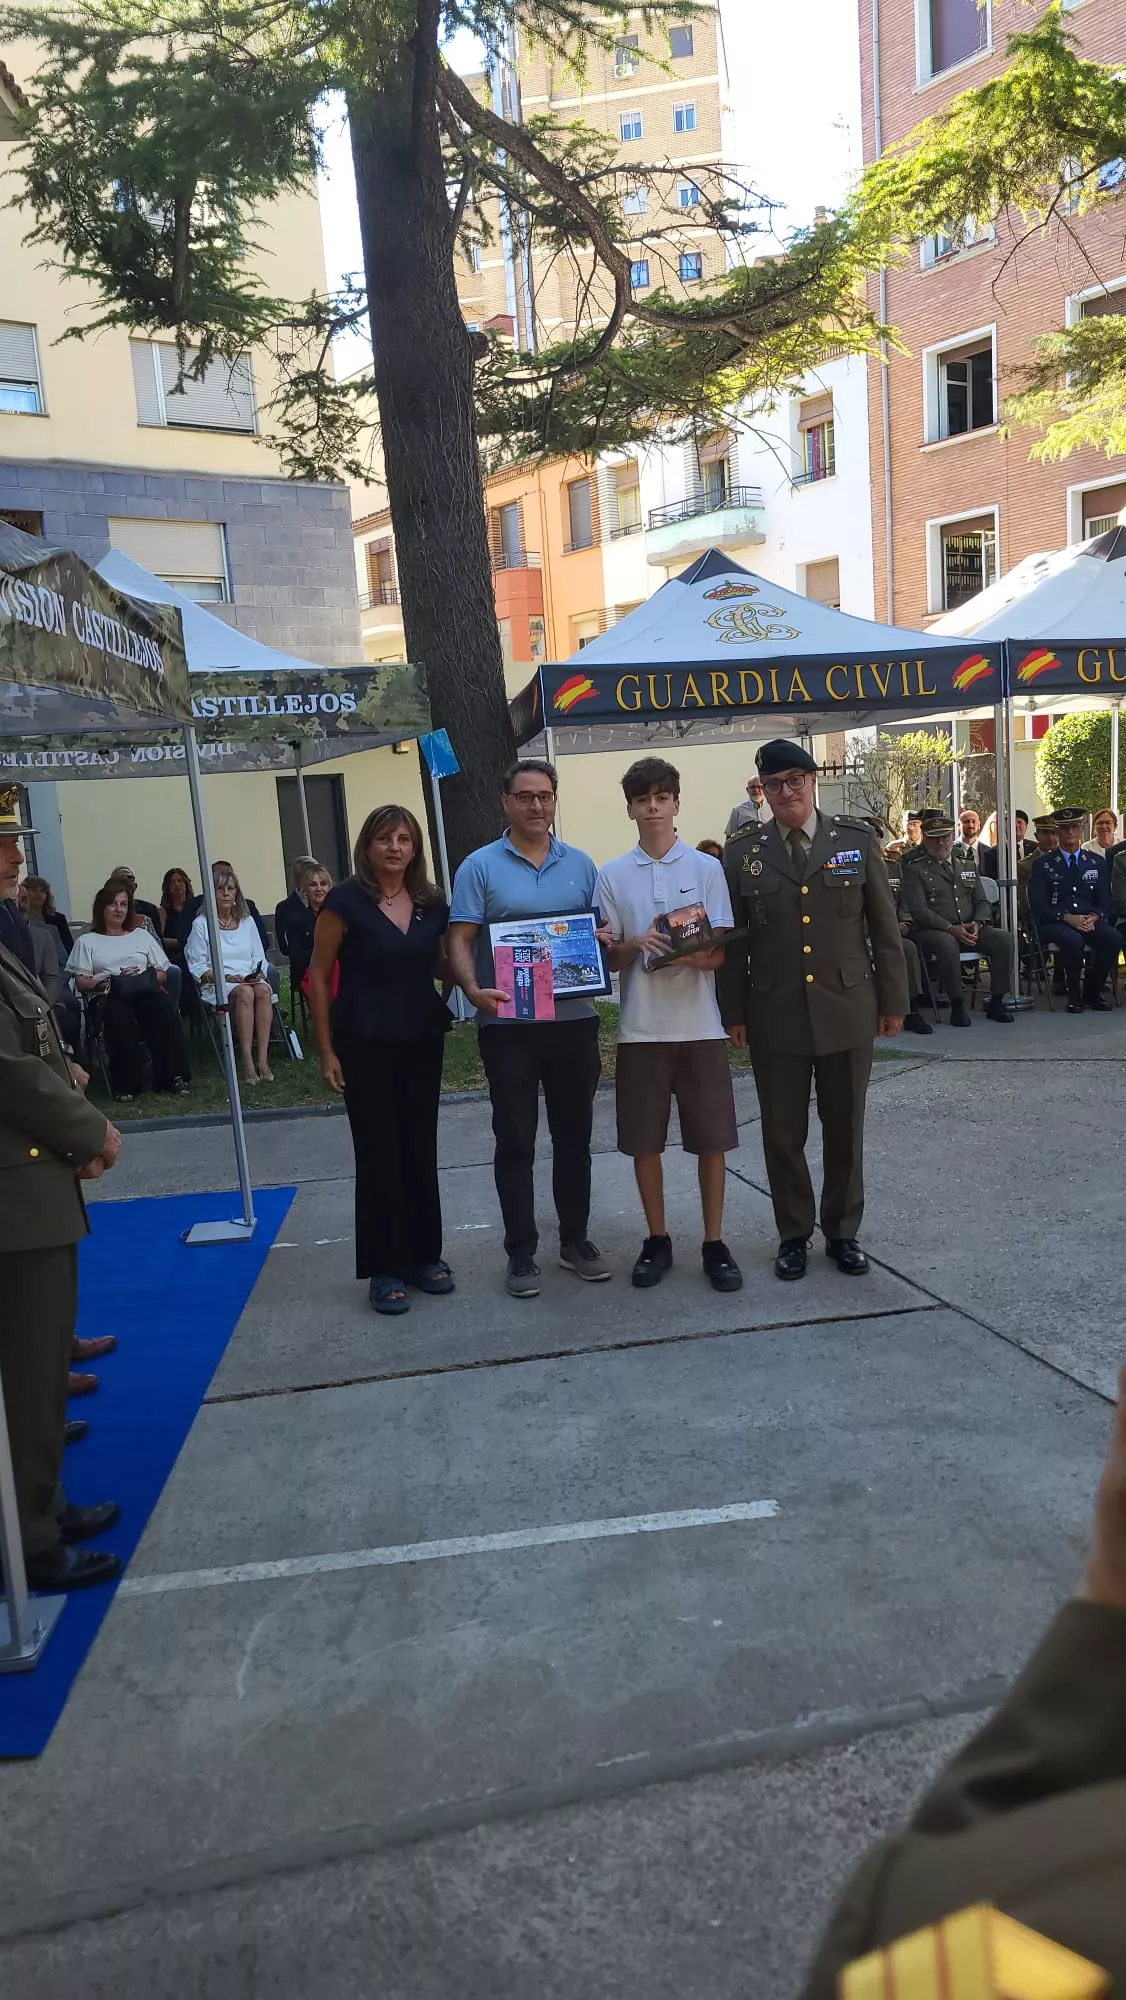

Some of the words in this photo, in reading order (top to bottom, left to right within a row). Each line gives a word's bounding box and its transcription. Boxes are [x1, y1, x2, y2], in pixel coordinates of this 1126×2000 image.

[71, 600, 165, 674] CASTILLEJOS
[615, 667, 813, 711] GUARDIA
[825, 660, 937, 700] CIVIL
[1077, 647, 1126, 682] GU
